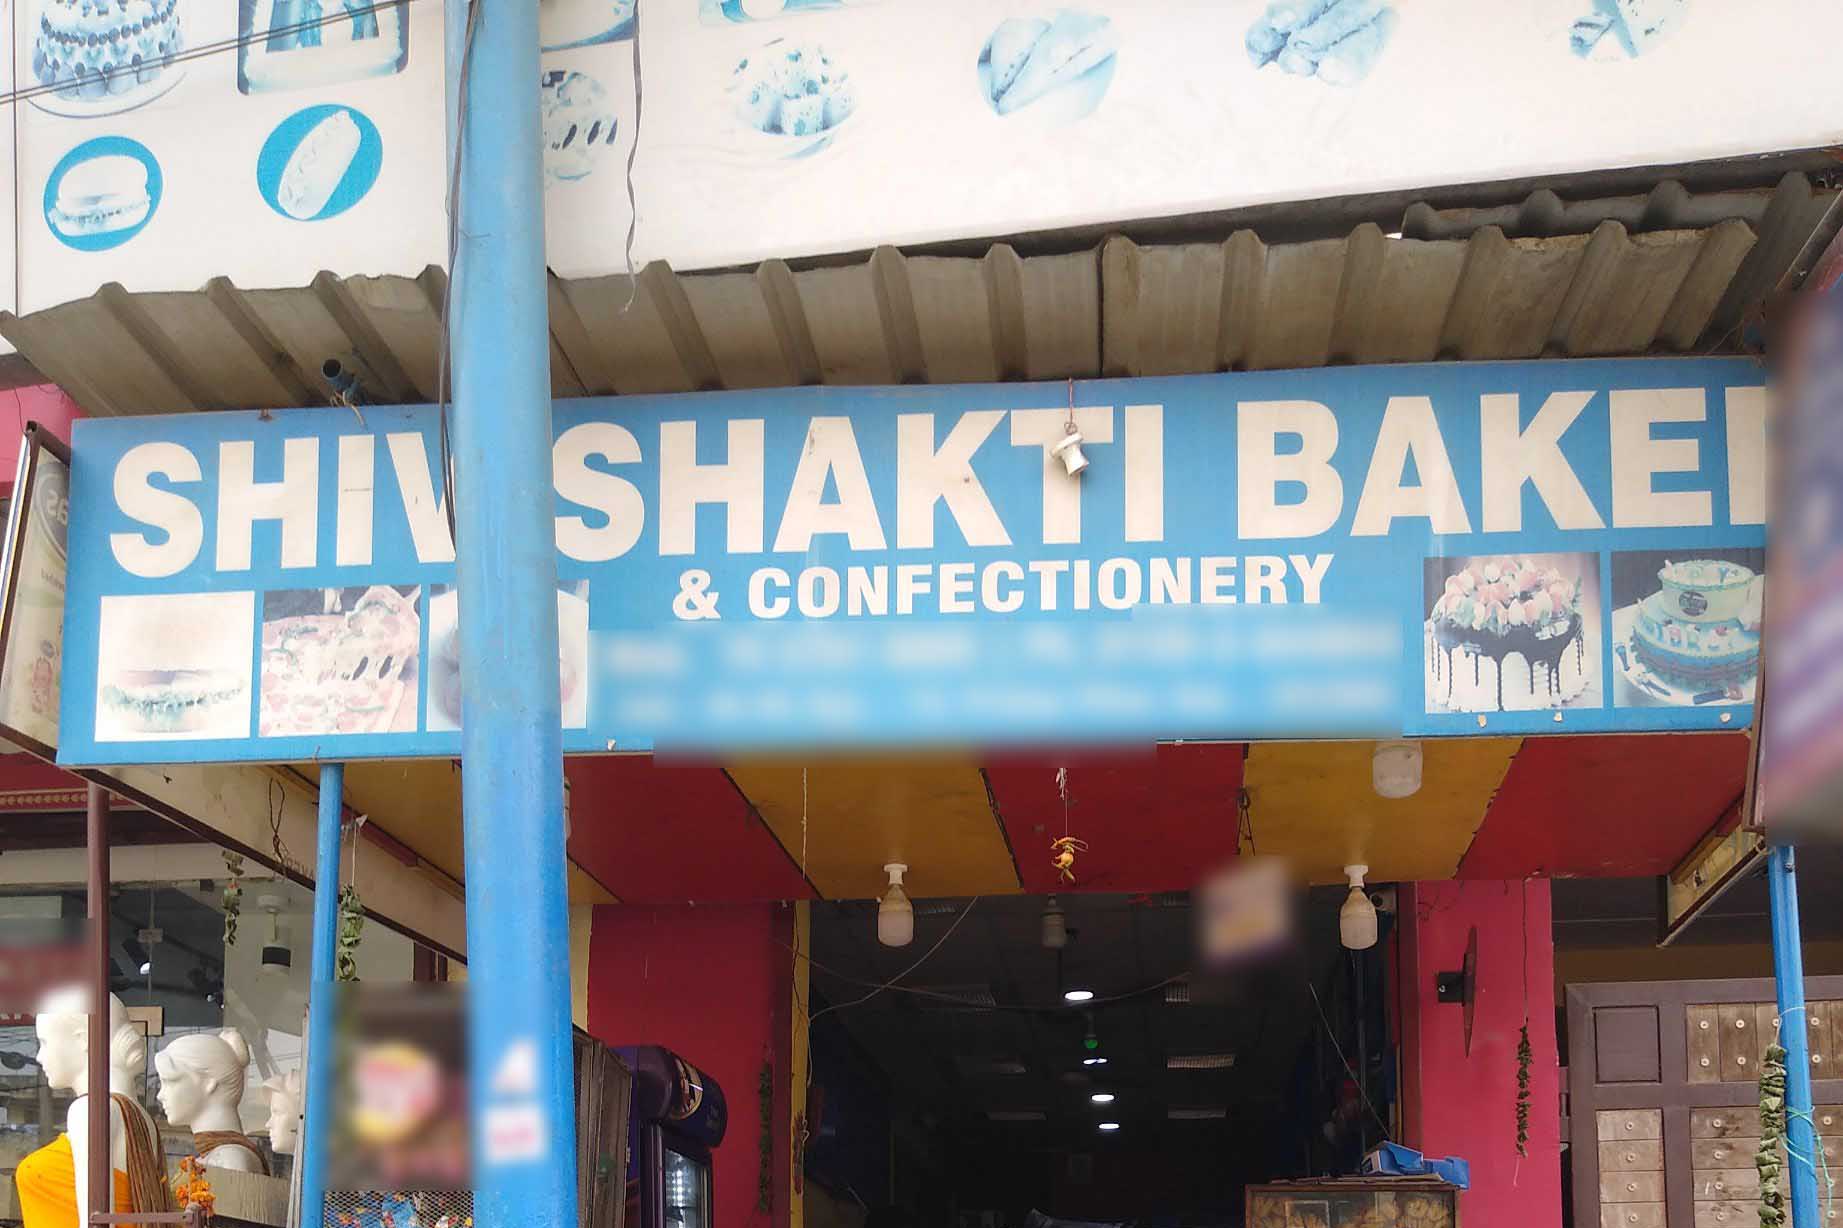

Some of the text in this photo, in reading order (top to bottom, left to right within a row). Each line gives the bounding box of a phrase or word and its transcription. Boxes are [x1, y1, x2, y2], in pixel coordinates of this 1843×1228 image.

[553, 404, 1165, 563] SHAKTI
[672, 553, 1335, 621] & CONFECTIONERY
